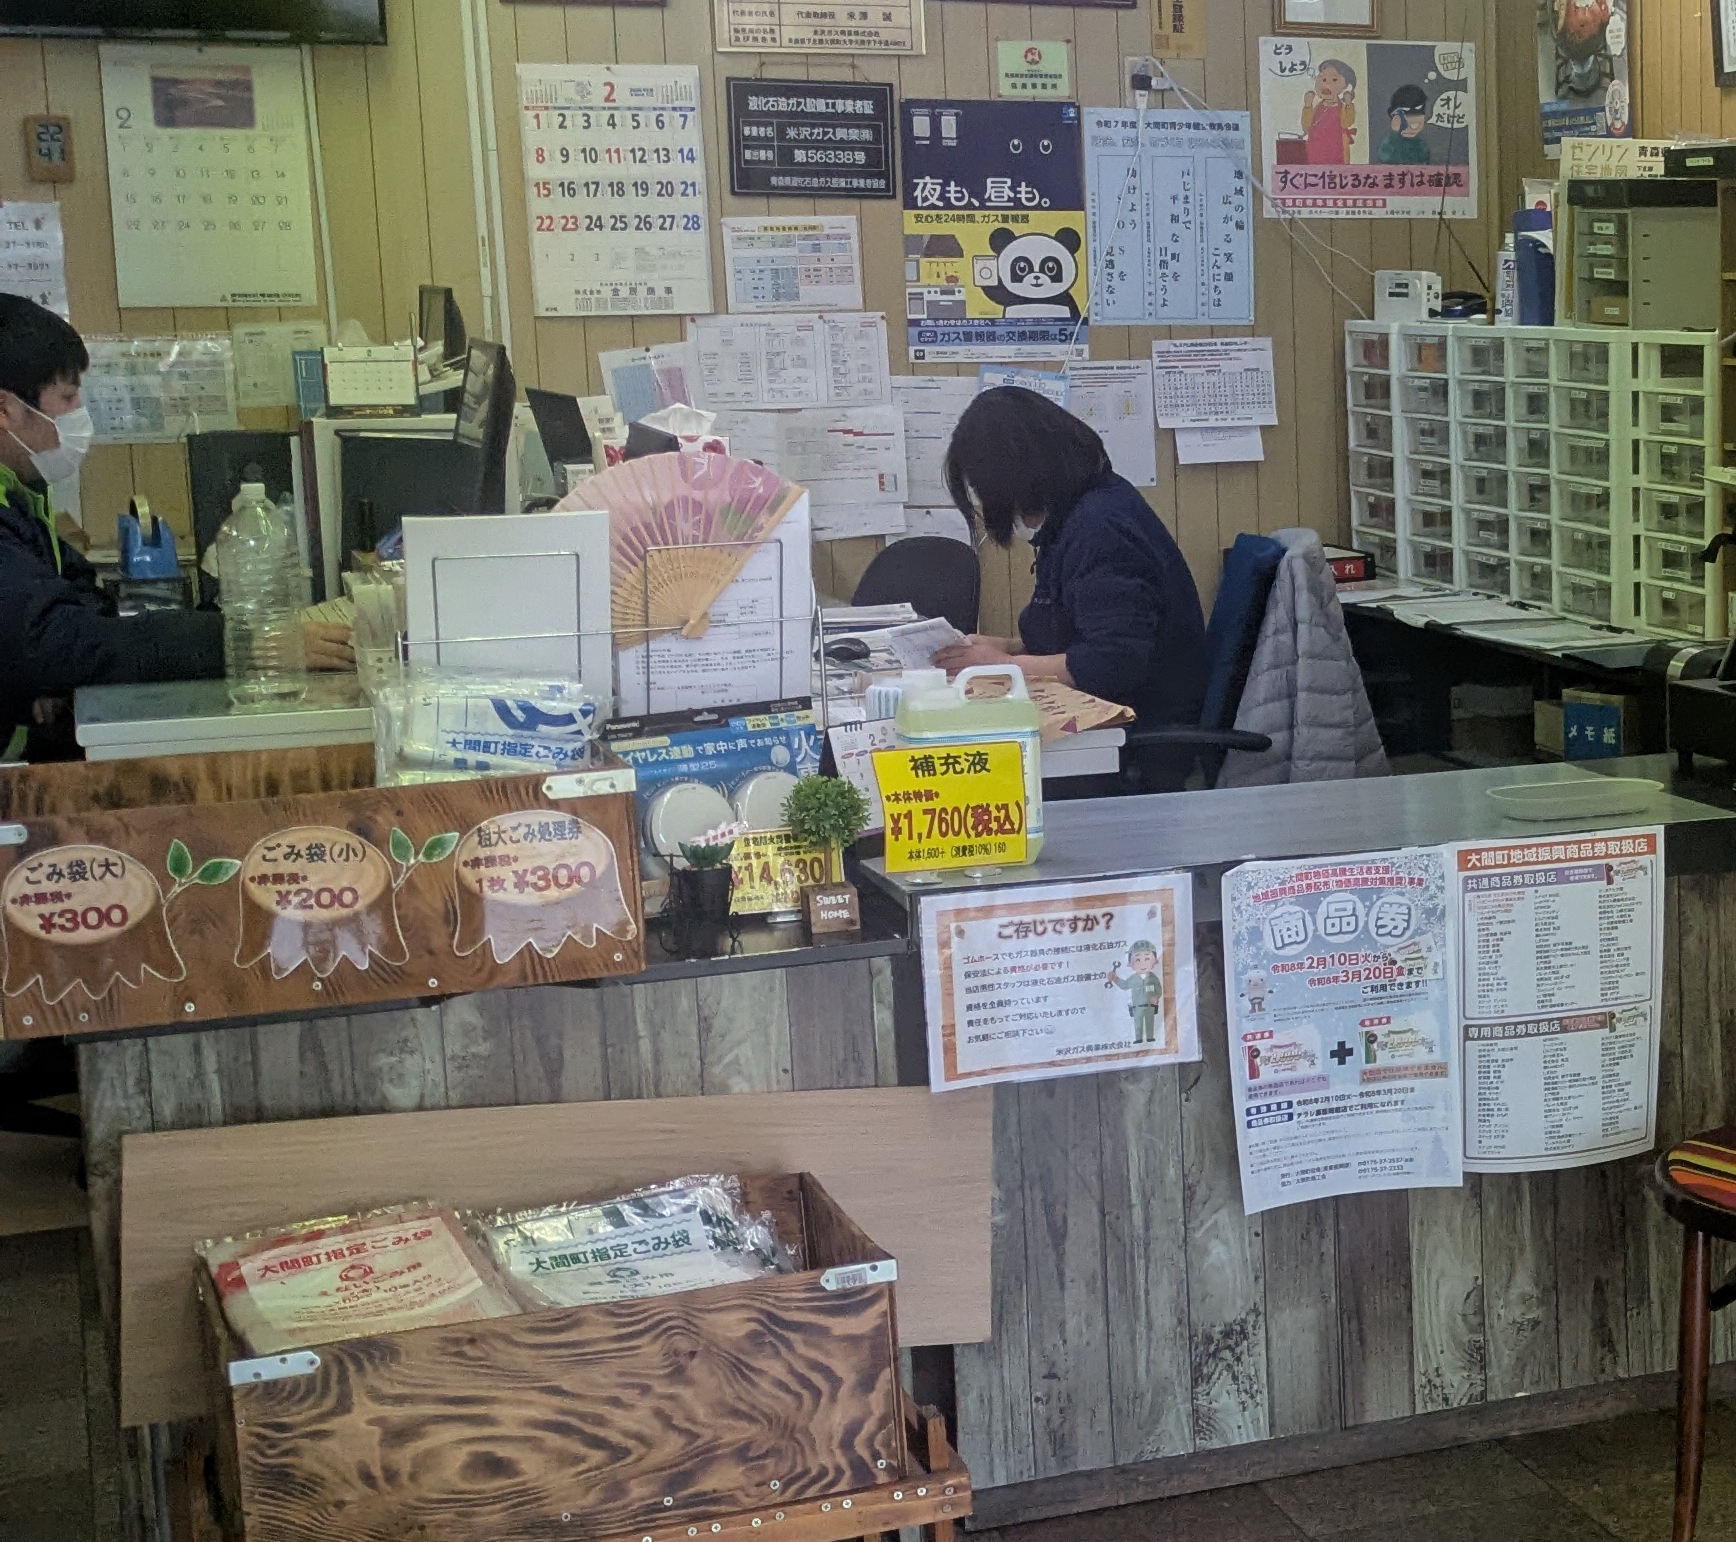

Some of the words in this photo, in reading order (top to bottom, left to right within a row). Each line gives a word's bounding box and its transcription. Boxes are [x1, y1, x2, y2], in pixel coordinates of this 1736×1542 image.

[1272, 43, 1293, 56] どう
[1279, 60, 1307, 74] しよう
[603, 81, 617, 104] 2
[116, 108, 132, 129] 2
[533, 113, 541, 130] 1
[558, 113, 568, 130] 2
[582, 113, 592, 130] 3
[606, 113, 617, 130] 4
[631, 113, 641, 130] 5
[655, 113, 665, 130] 6
[679, 113, 688, 130] 7
[1434, 112, 1467, 126] だけど
[535, 146, 545, 164] 8
[560, 146, 570, 164] 9
[580, 146, 598, 164] 10
[605, 146, 622, 164] 11
[629, 146, 647, 164] 12
[653, 146, 671, 164] 13
[678, 146, 696, 164] 14
[793, 149, 866, 164] 第56338号
[1570, 143, 1629, 163] ゼンリン
[533, 181, 551, 198] 15
[558, 181, 576, 198] 16
[583, 181, 600, 198] 17
[607, 181, 625, 198] 18
[631, 181, 650, 198] 19
[656, 181, 674, 198] 20
[680, 181, 697, 198] 21
[913, 175, 1051, 208] 夜も、昼も。
[1275, 169, 1379, 192] すぐに信じるな
[1382, 170, 1464, 190] まずは確認
[536, 215, 555, 233] 22
[560, 215, 579, 233] 23
[584, 215, 604, 233] 24
[609, 215, 628, 233] 25
[633, 215, 653, 233] 26
[658, 215, 675, 233] 27
[682, 215, 700, 233] 28
[1211, 247, 1222, 308] こんにちは
[444, 737, 587, 762] 大間町指定ごみ袋
[868, 733, 878, 747] 2
[909, 751, 992, 780] 補充液
[891, 789, 935, 804] 本体特価
[476, 816, 583, 849] 粗大ごみ処理券
[889, 801, 1024, 843] ¥1,760(税込)
[261, 841, 368, 865] ごみ袋(小)
[1467, 835, 1648, 868] 大間町地域振興商品券取扱店
[25, 855, 127, 886] ごみ袋(大)
[475, 875, 509, 896] 1枚
[513, 861, 598, 892] ¥300
[1467, 871, 1558, 891] 共通商品券取扱店
[274, 887, 360, 911] ¥200
[38, 904, 129, 936] ¥300
[997, 911, 1116, 940] ご存じですか？
[1268, 900, 1413, 951] 商品券
[1467, 1020, 1561, 1039] 専用商品券取扱店
[528, 1229, 692, 1273] 大間町指定ごみ袋
